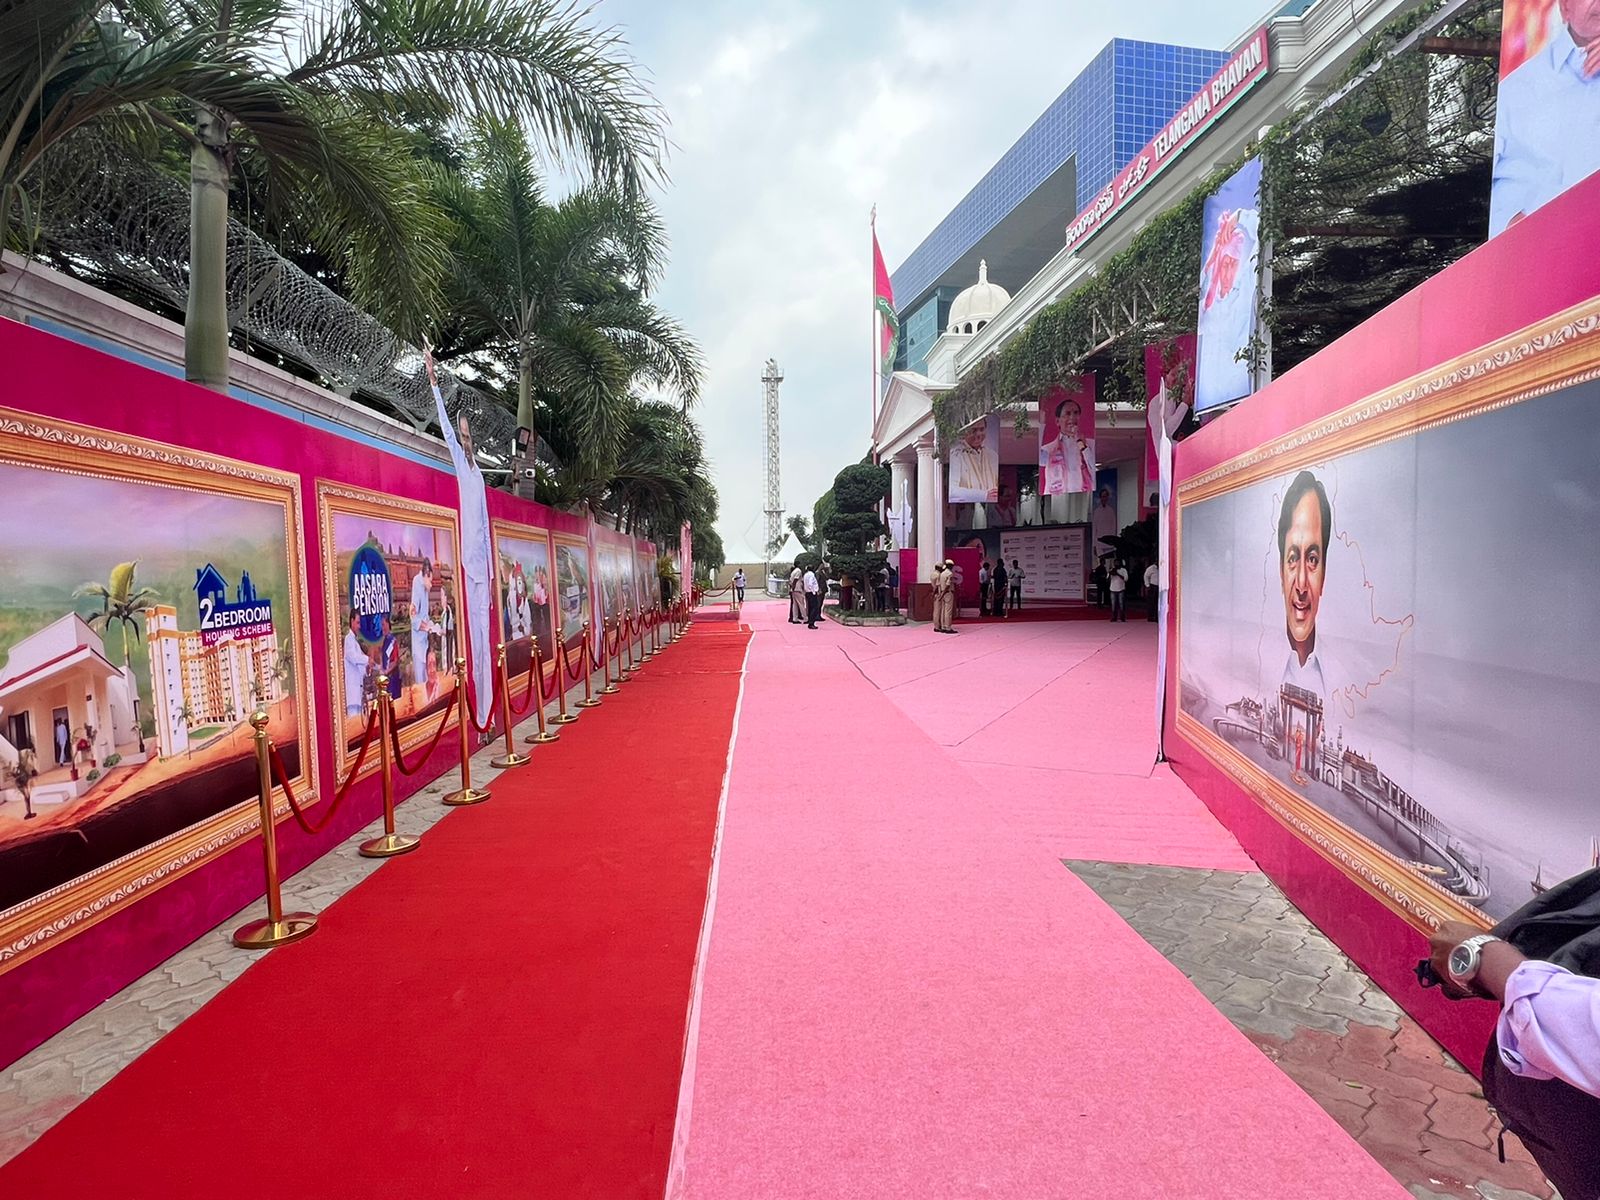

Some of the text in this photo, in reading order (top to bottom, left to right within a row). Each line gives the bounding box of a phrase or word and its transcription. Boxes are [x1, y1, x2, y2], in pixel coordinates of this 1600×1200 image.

[1153, 37, 1262, 161] TELANGANA BHAVAN
[354, 573, 388, 594] AASARA
[200, 598, 271, 629] 2 BEDROOM
[353, 592, 390, 616] PENSION
[242, 623, 272, 636] SCHEME
